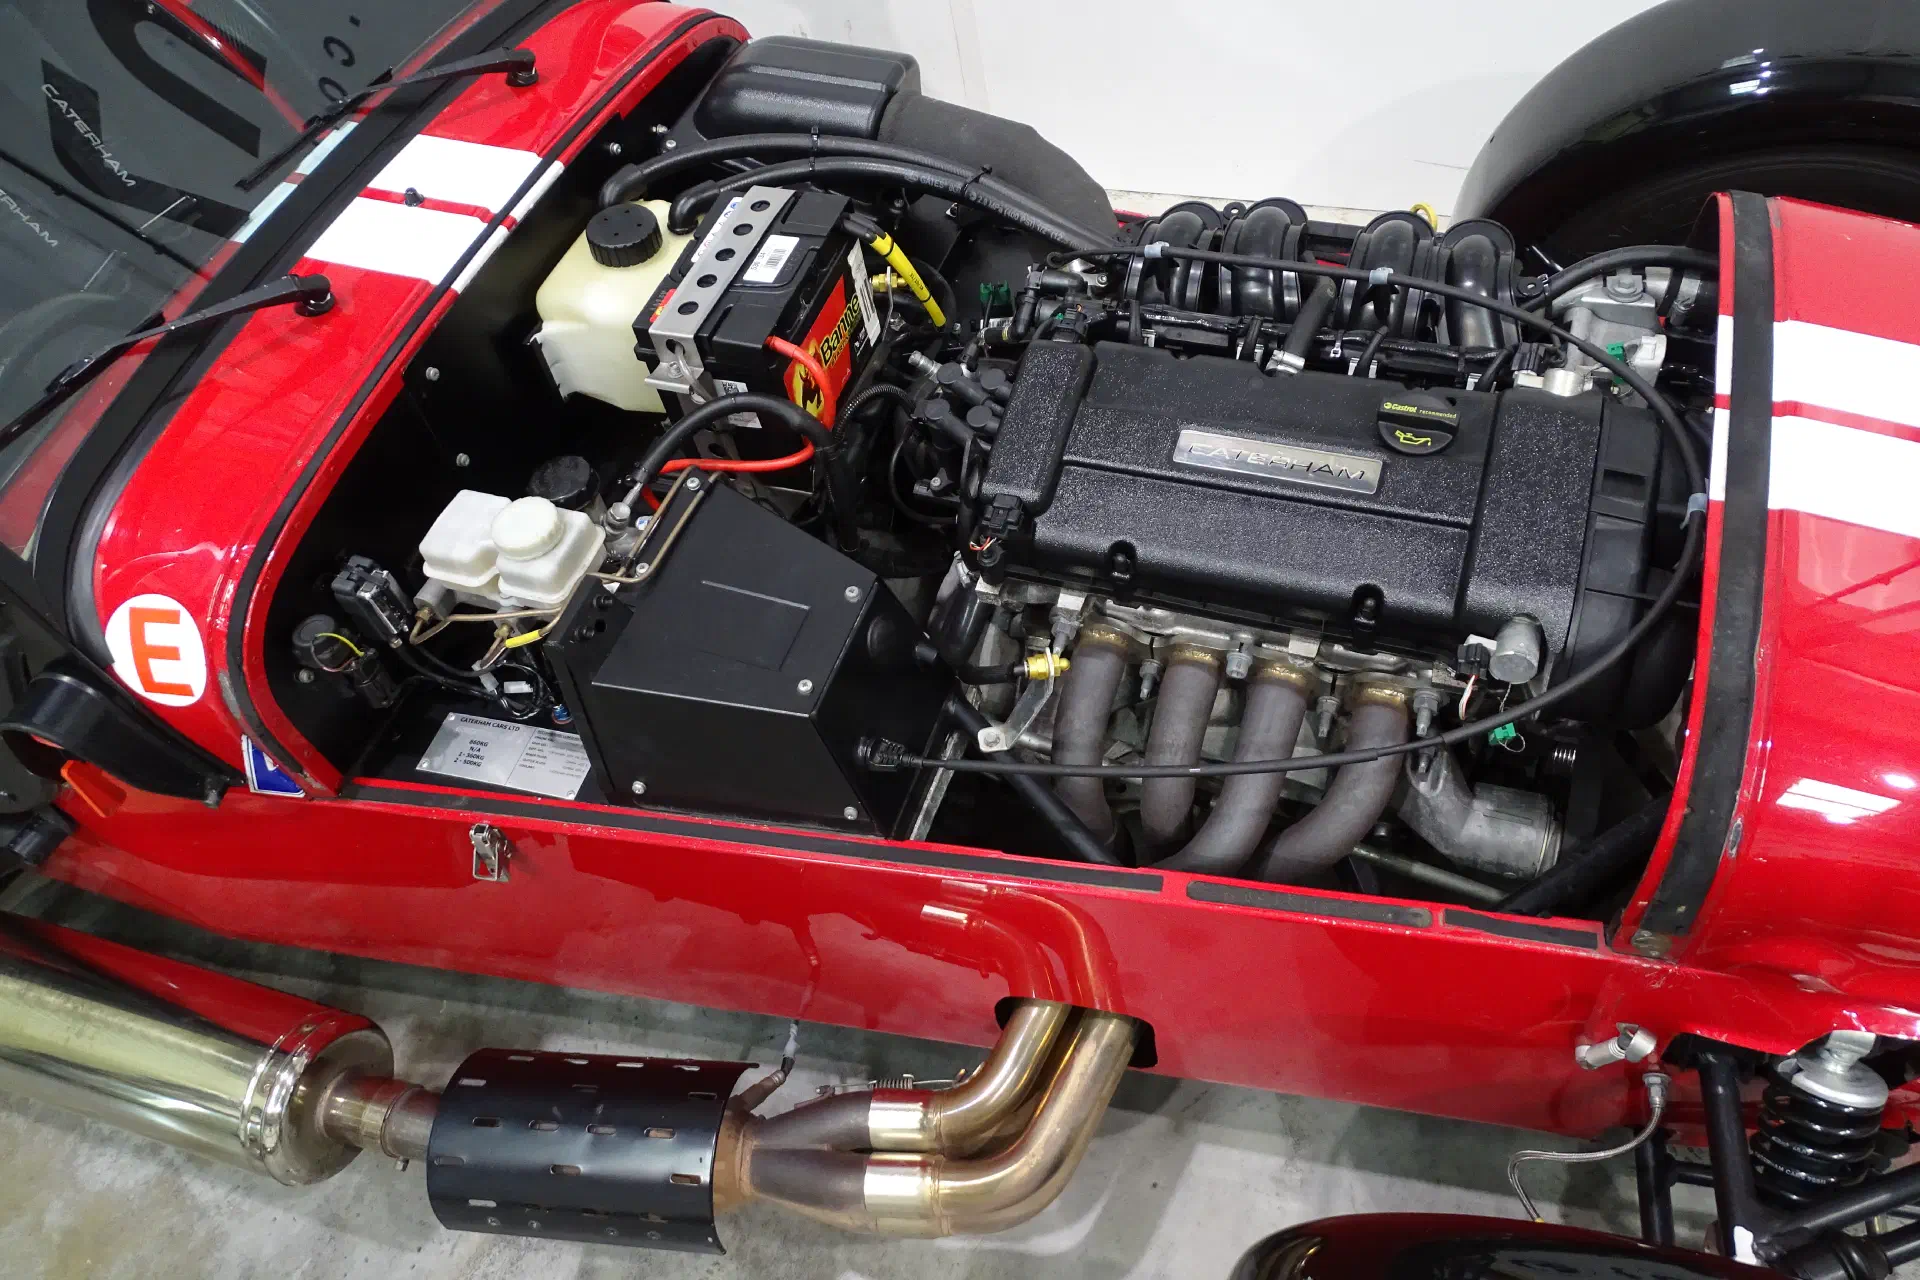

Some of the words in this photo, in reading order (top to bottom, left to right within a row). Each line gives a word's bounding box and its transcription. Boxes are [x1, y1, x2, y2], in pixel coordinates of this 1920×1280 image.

[41, 83, 137, 187] CATERHAM
[819, 291, 860, 369] Banne
[1391, 403, 1417, 413] Castrol
[1419, 409, 1457, 419] recommended
[1188, 443, 1365, 481] CATERHAM
[129, 606, 196, 698] E
[460, 716, 491, 727] CATERHAM
[492, 722, 507, 730] CARS
